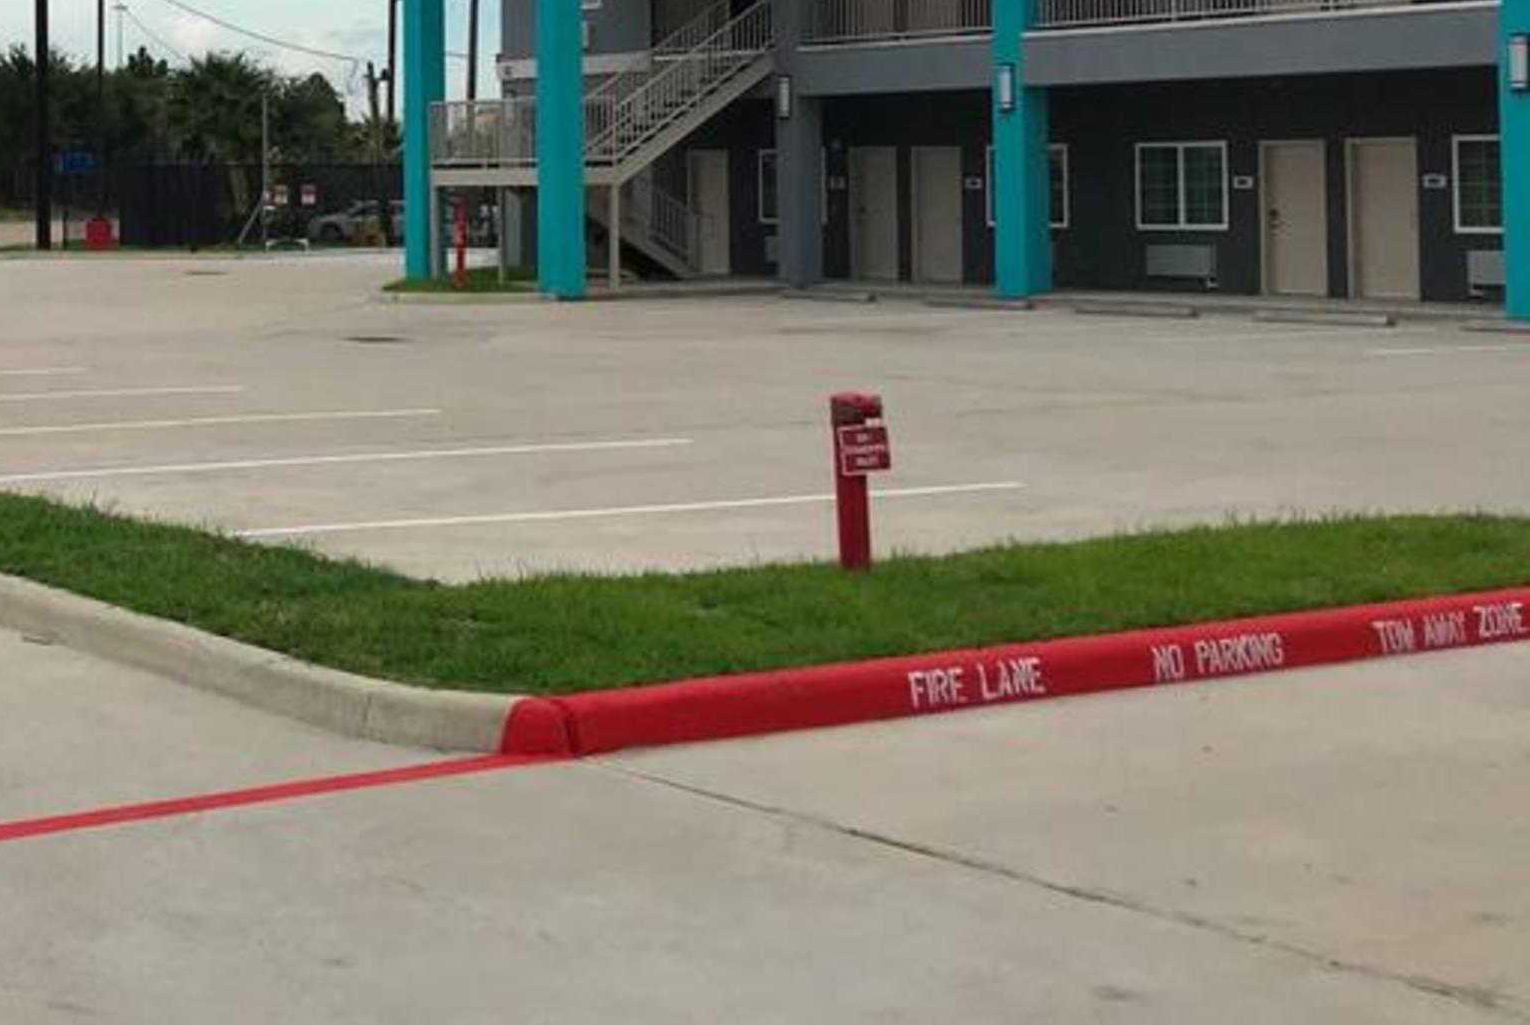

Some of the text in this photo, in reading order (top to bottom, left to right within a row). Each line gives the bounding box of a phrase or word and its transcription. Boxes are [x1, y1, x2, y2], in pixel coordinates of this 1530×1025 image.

[1371, 618, 1415, 653] TOW
[1472, 602, 1530, 638] ZONE
[1150, 632, 1284, 681] NO PARKING
[907, 656, 1047, 710] FIRE LANE
